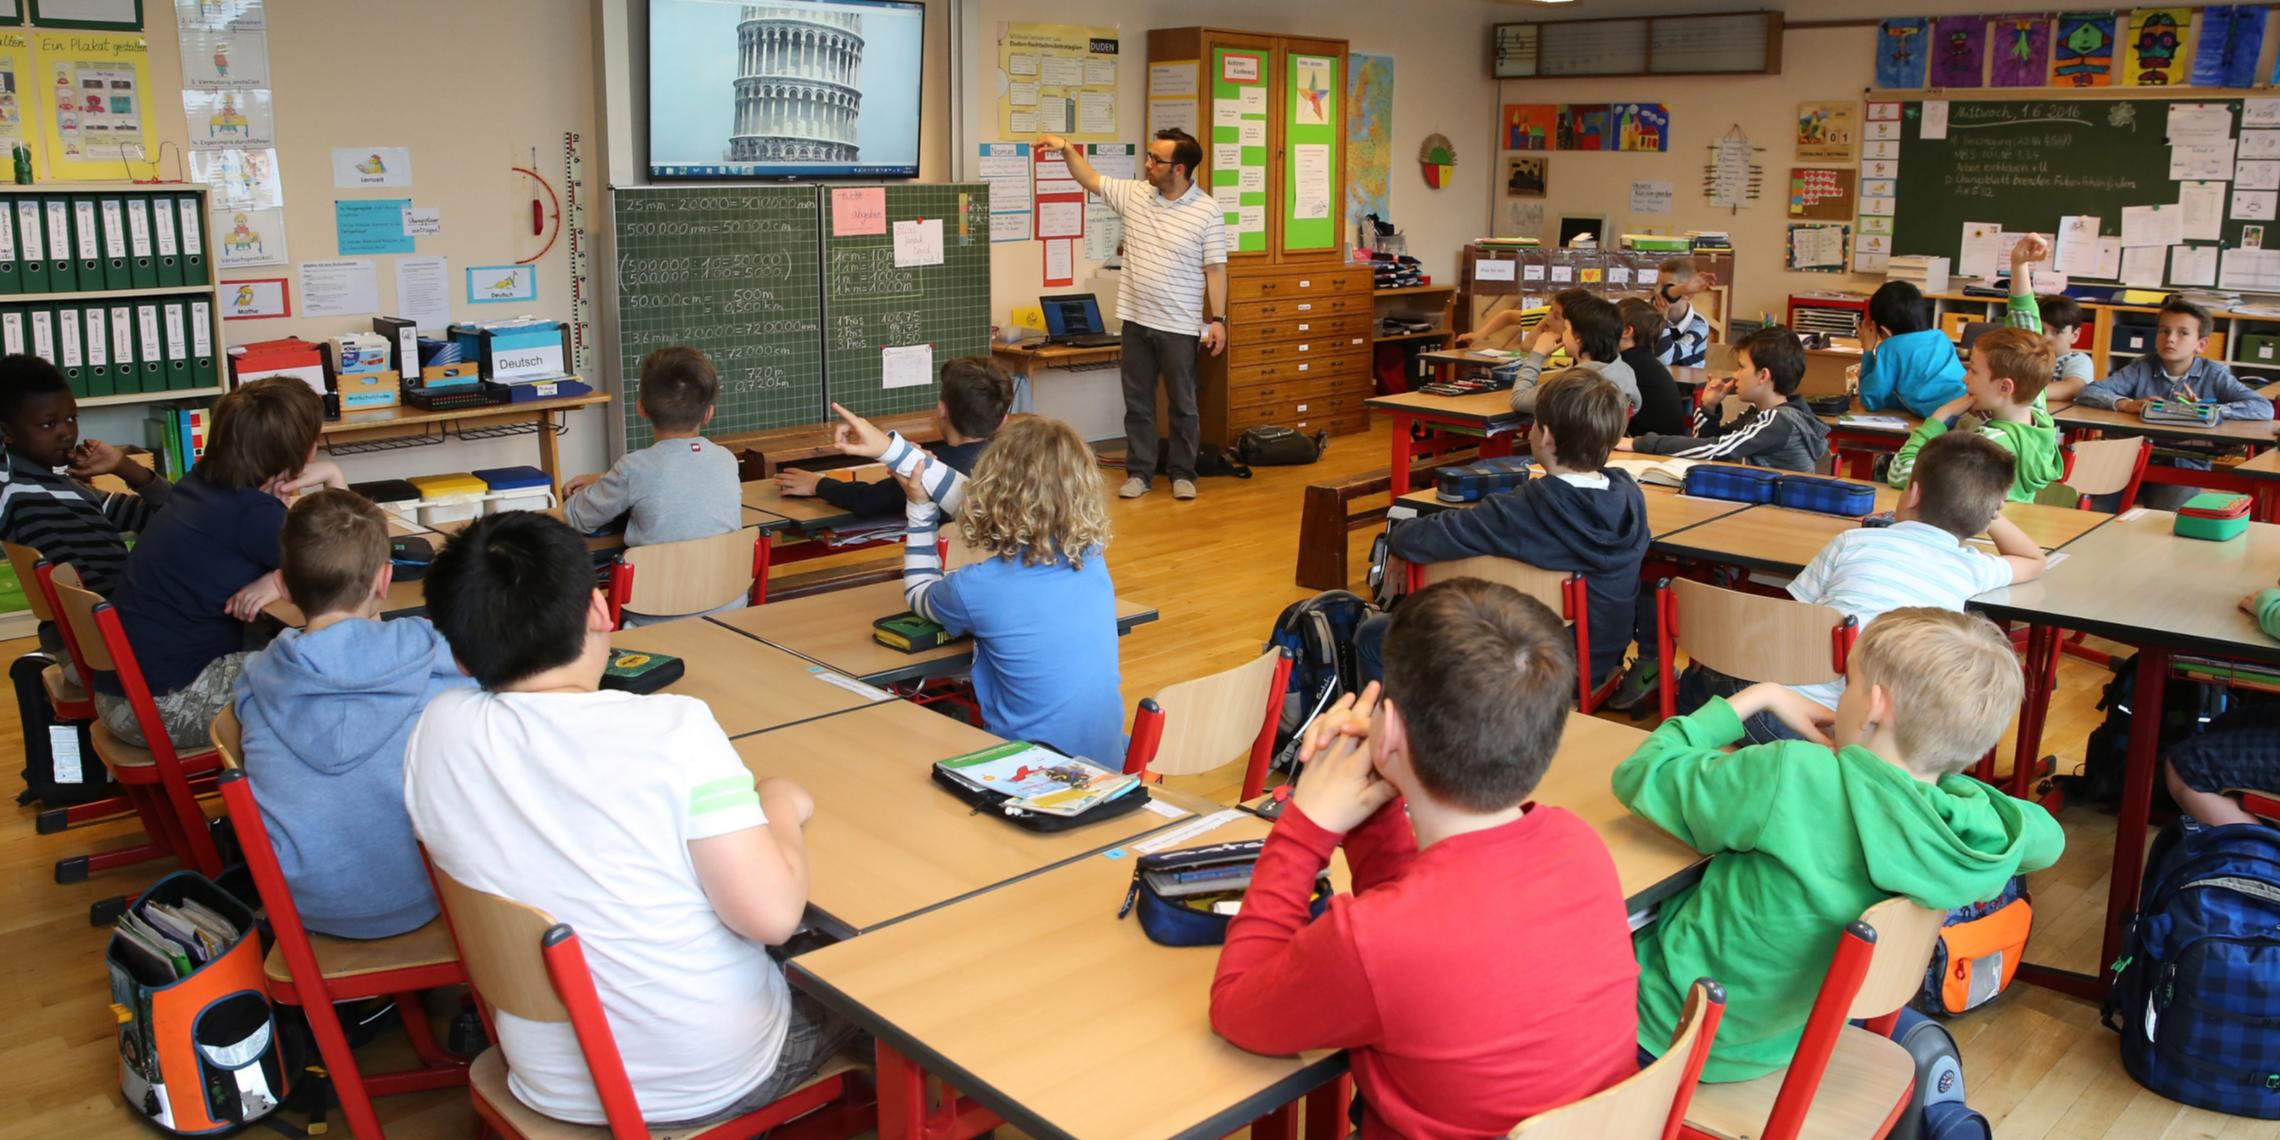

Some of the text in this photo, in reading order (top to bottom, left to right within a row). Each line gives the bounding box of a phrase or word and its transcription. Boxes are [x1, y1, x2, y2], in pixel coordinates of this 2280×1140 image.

[42, 38, 147, 56] Ein Plakat gestalten
[1090, 42, 1115, 52] DUDEN
[2047, 103, 2081, 119] 2016
[1830, 133, 1836, 142] 0
[499, 356, 543, 370] Deutsch
